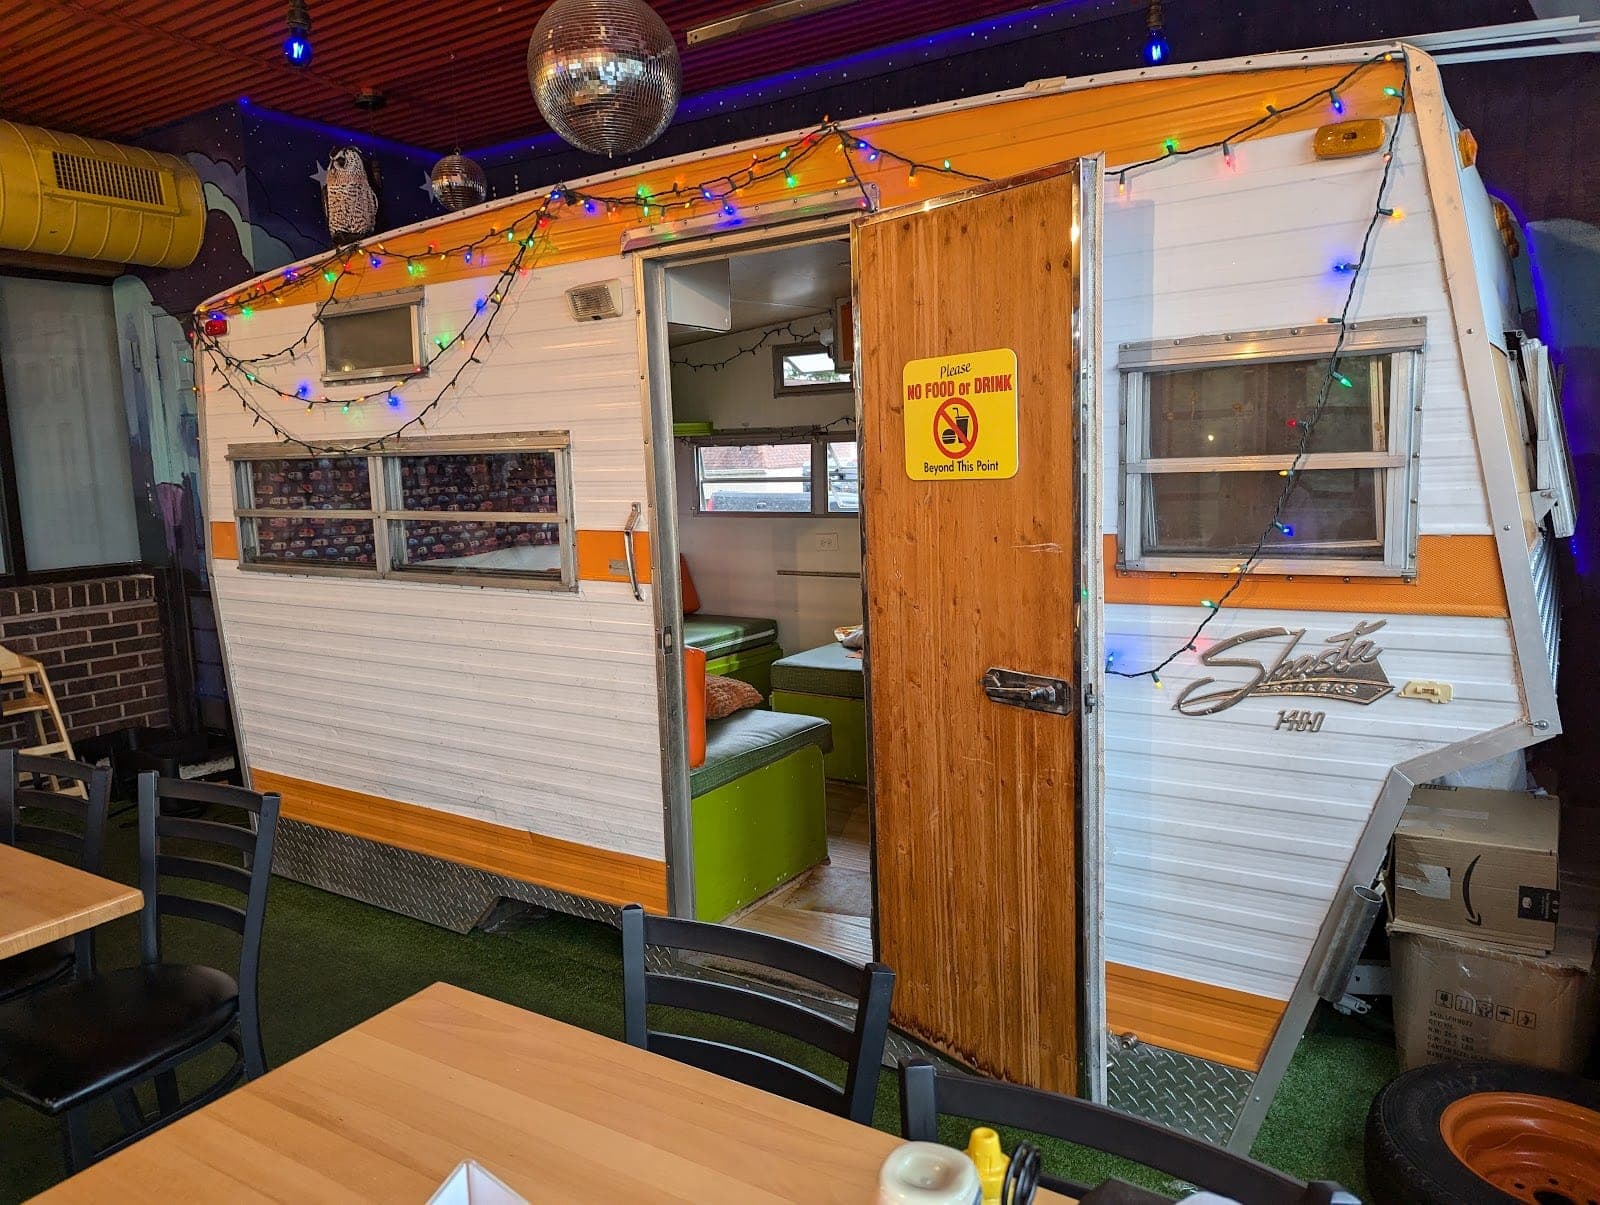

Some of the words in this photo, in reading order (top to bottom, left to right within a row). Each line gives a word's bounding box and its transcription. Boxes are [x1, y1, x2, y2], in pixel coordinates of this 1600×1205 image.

[940, 362, 972, 379] Please
[907, 383, 921, 400] NO
[925, 380, 954, 399] FOOD
[959, 382, 971, 396] or
[974, 374, 1012, 394] DRINK
[923, 460, 955, 476] Beyond
[957, 460, 974, 472] This
[976, 459, 999, 471] Point
[1172, 619, 1387, 716] Shasta
[1257, 682, 1359, 694] TRAILERS
[1275, 709, 1326, 733] 1400
